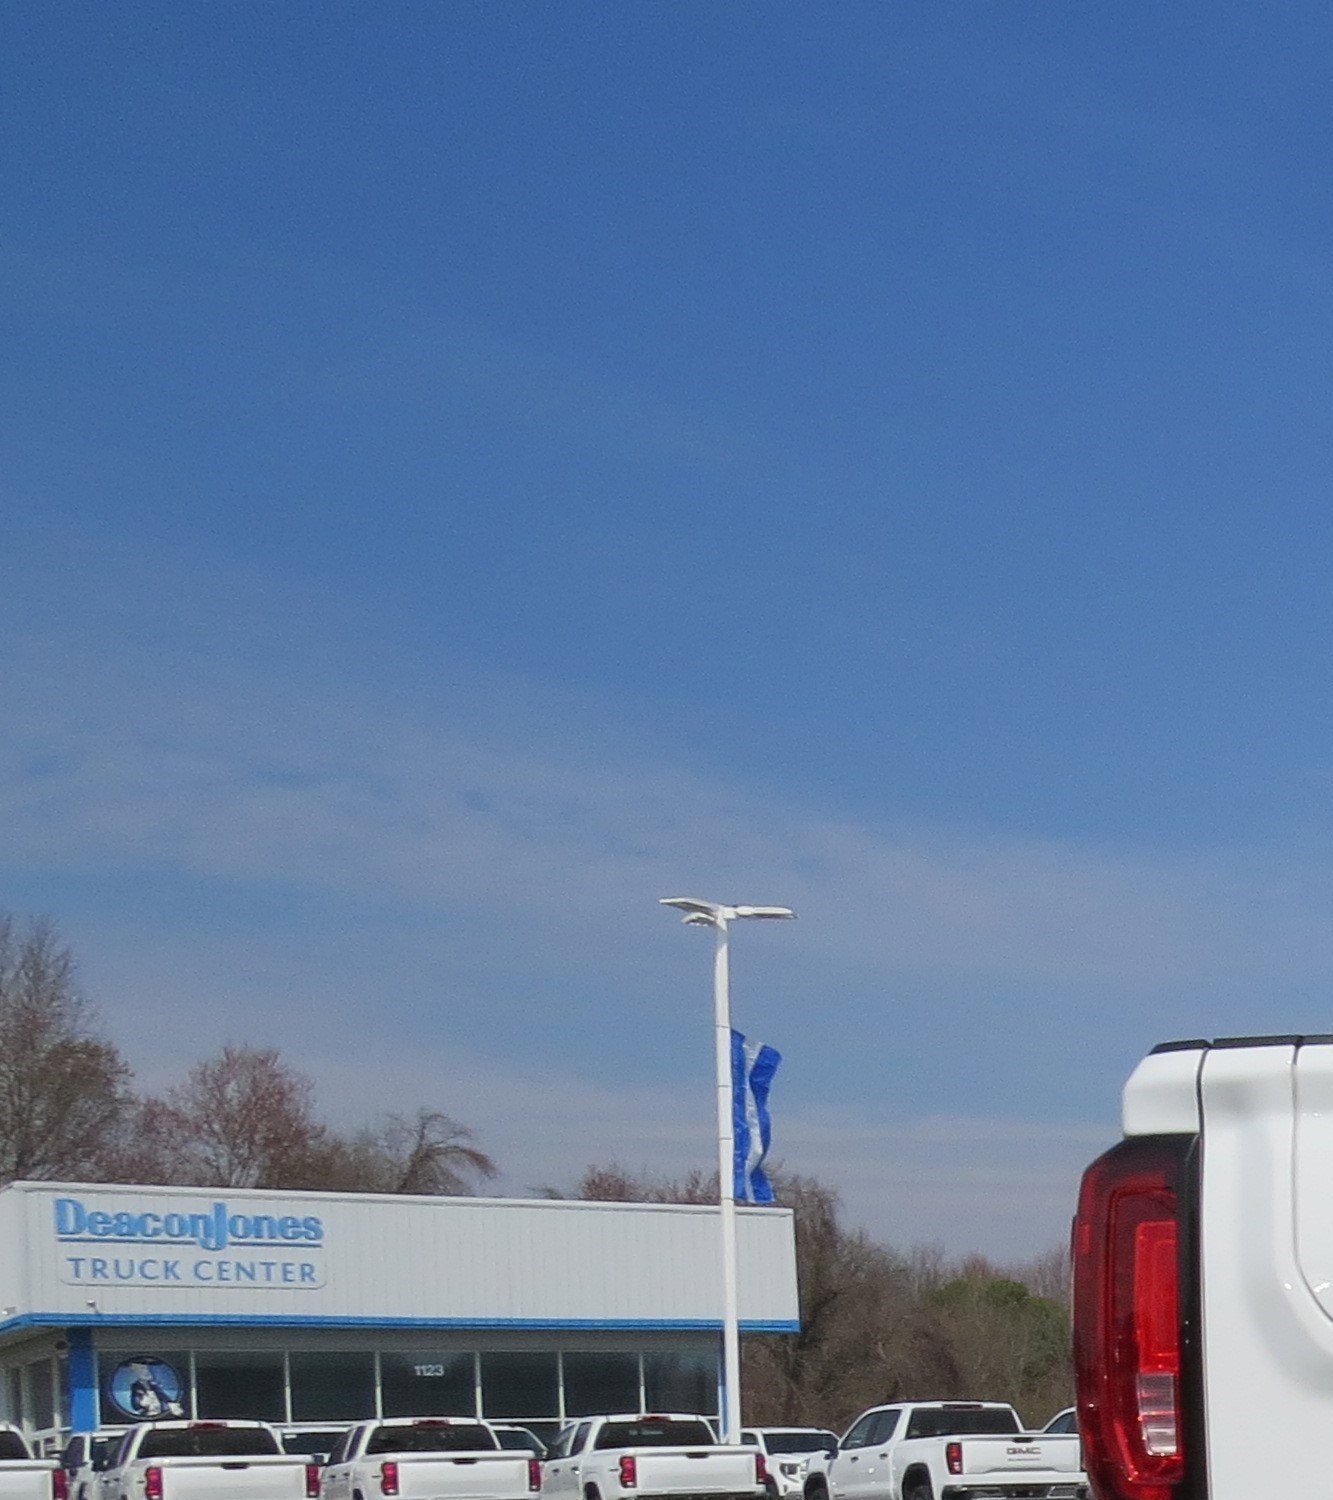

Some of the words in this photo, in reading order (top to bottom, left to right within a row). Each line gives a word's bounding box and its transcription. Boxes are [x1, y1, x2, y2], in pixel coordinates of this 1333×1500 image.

[55, 1198, 324, 1250] DeaconJones
[67, 1258, 182, 1280] TRUCK
[193, 1260, 316, 1282] CENTER
[414, 1364, 444, 1376] 1123
[1006, 1447, 1042, 1455] GMC
